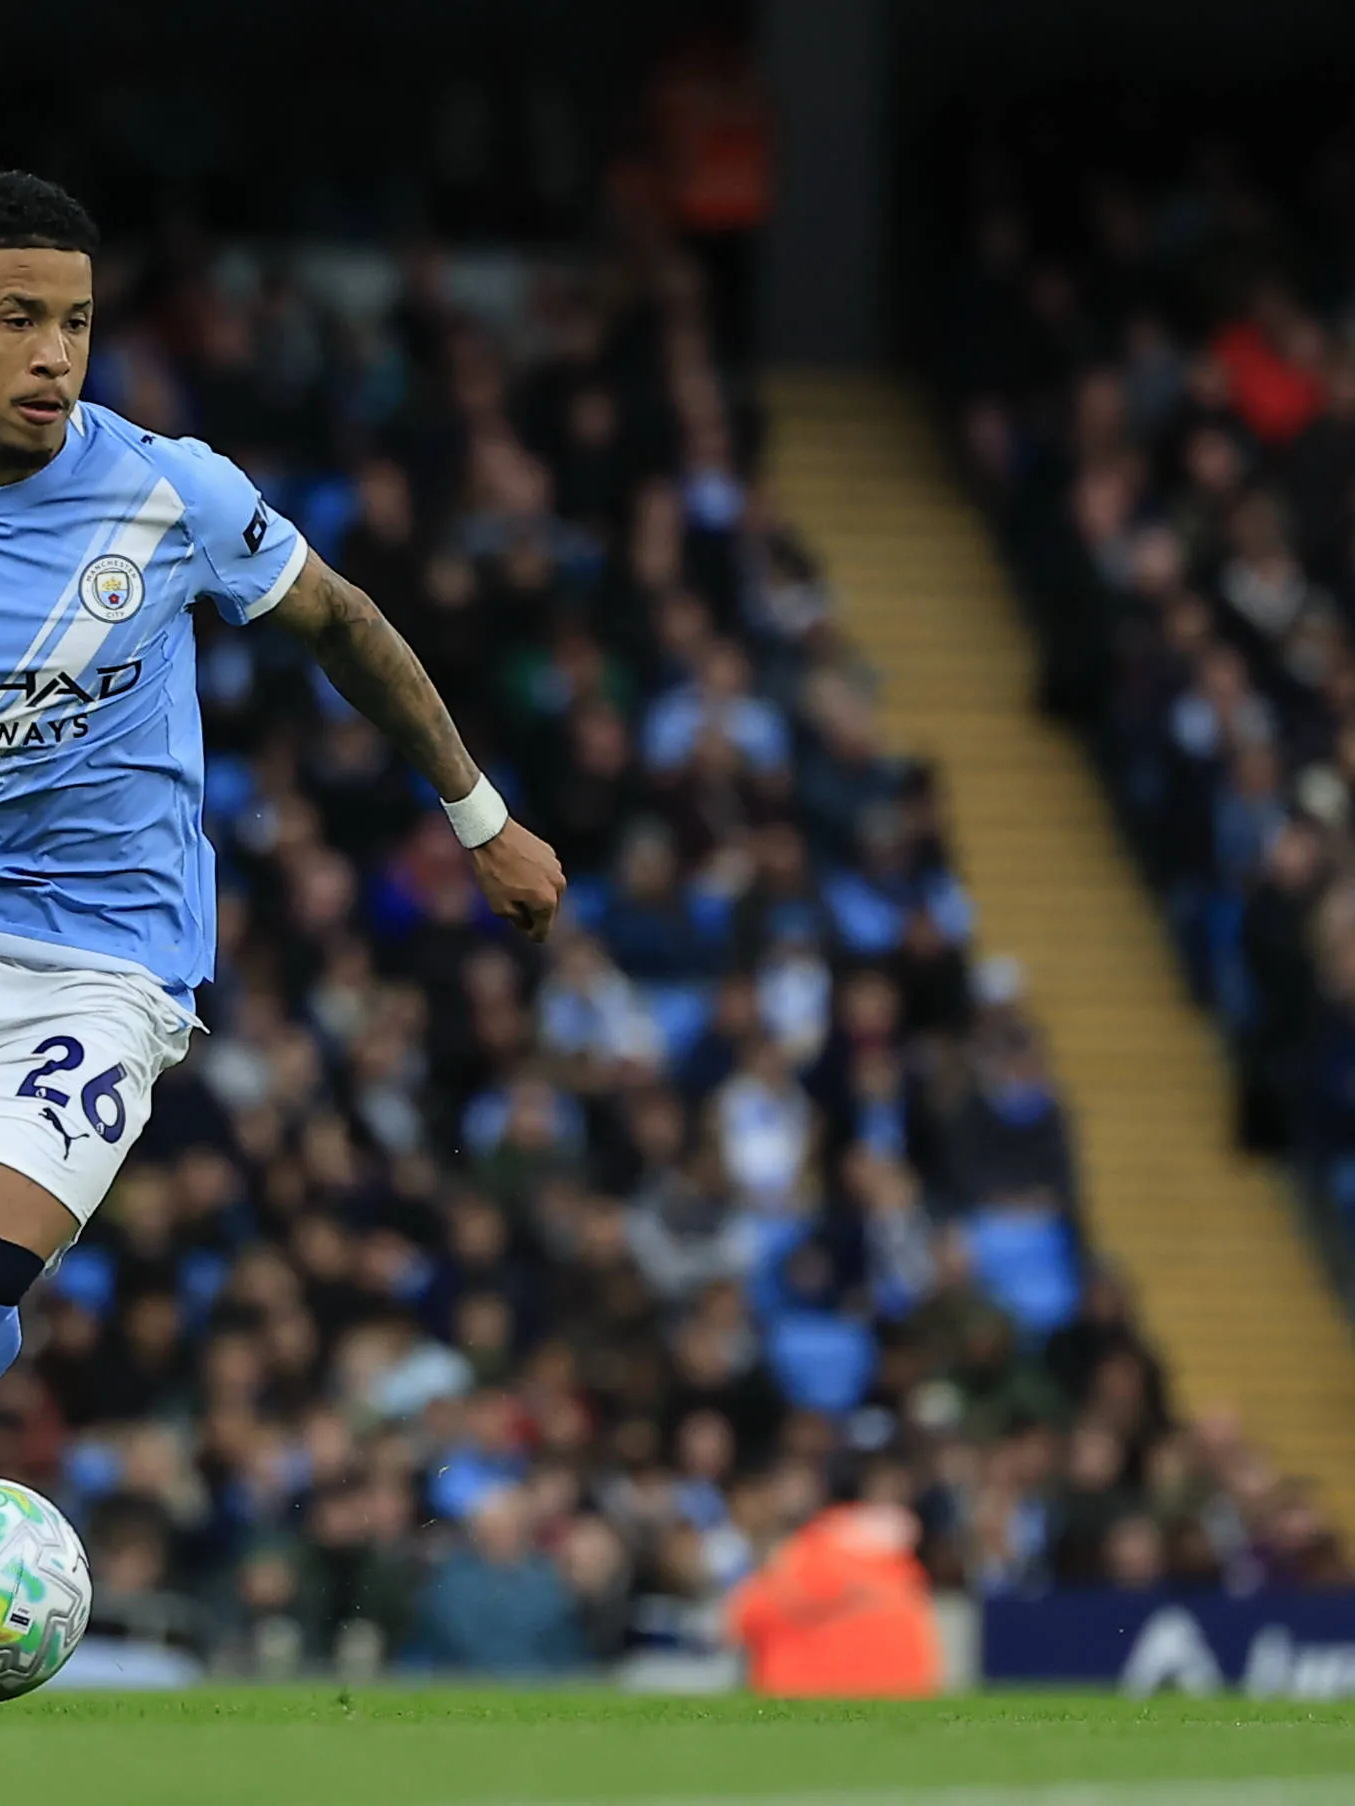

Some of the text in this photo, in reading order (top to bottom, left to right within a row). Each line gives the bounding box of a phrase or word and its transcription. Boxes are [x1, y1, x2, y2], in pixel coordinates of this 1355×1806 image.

[86, 559, 137, 582] MANCHESTER
[106, 607, 125, 618] CITY
[15, 1035, 127, 1144] 26
